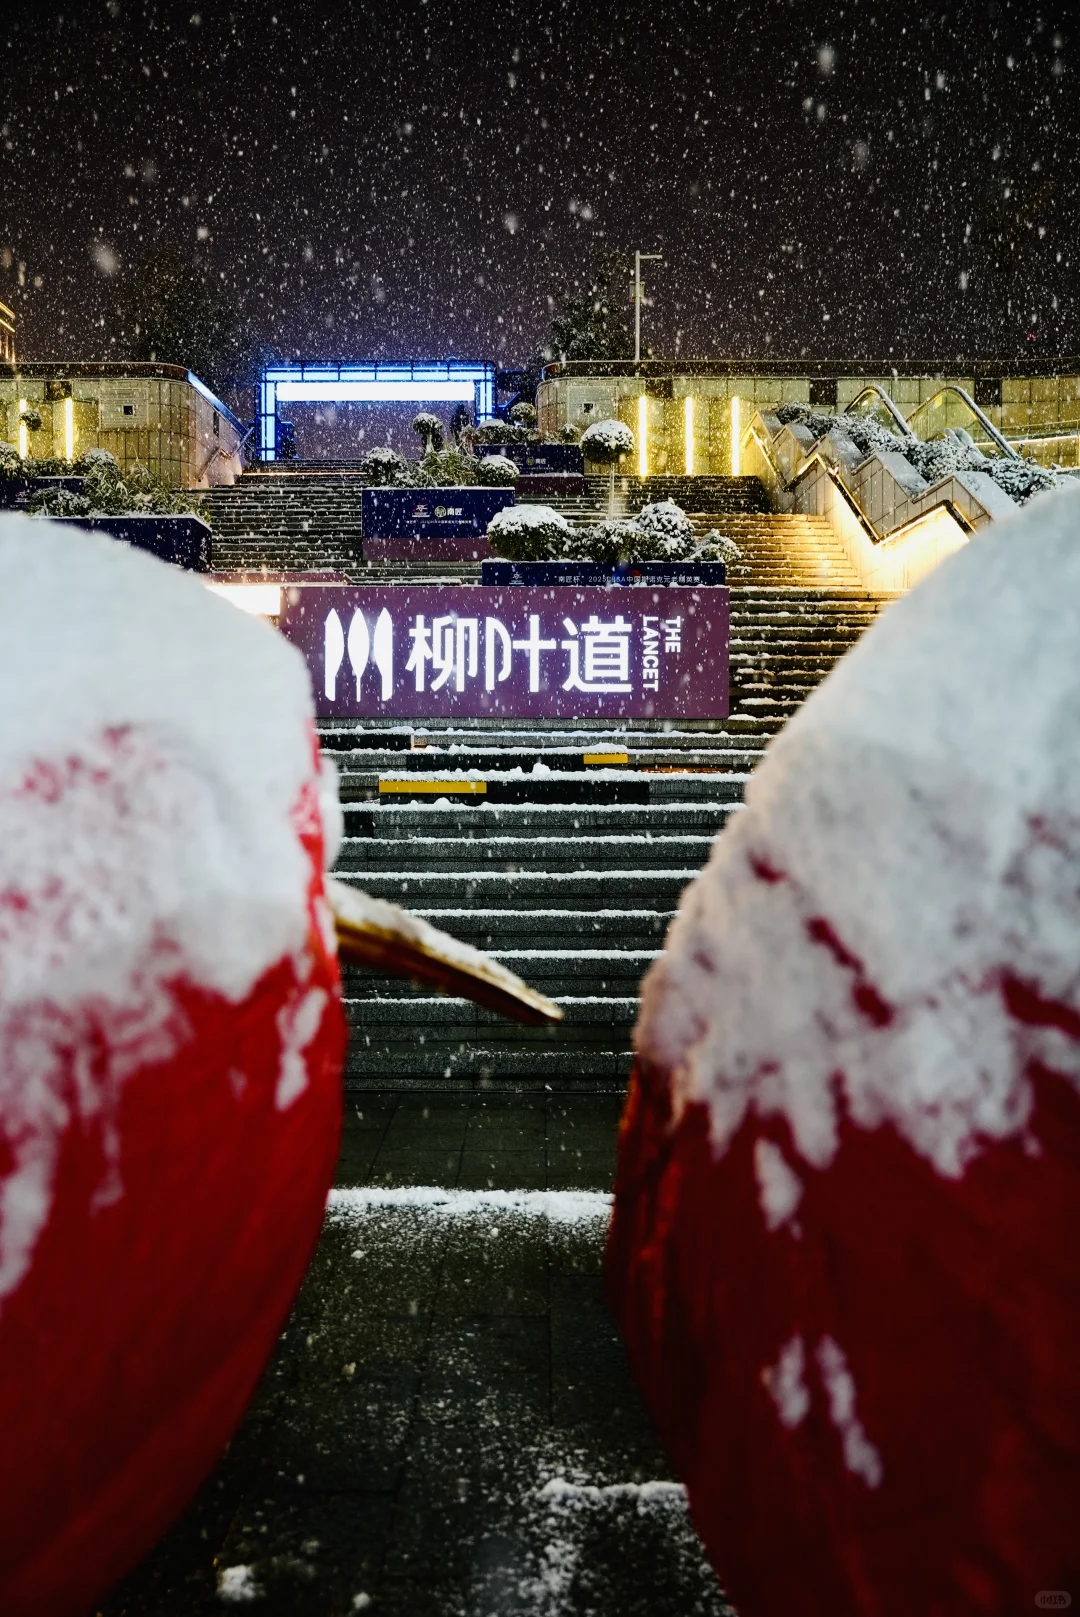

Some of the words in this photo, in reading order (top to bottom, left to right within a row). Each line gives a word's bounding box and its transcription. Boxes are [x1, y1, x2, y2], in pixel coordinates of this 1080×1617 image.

[405, 614, 632, 693] 柳叶道
[642, 614, 660, 692] LANCET
[664, 615, 682, 653] THE
